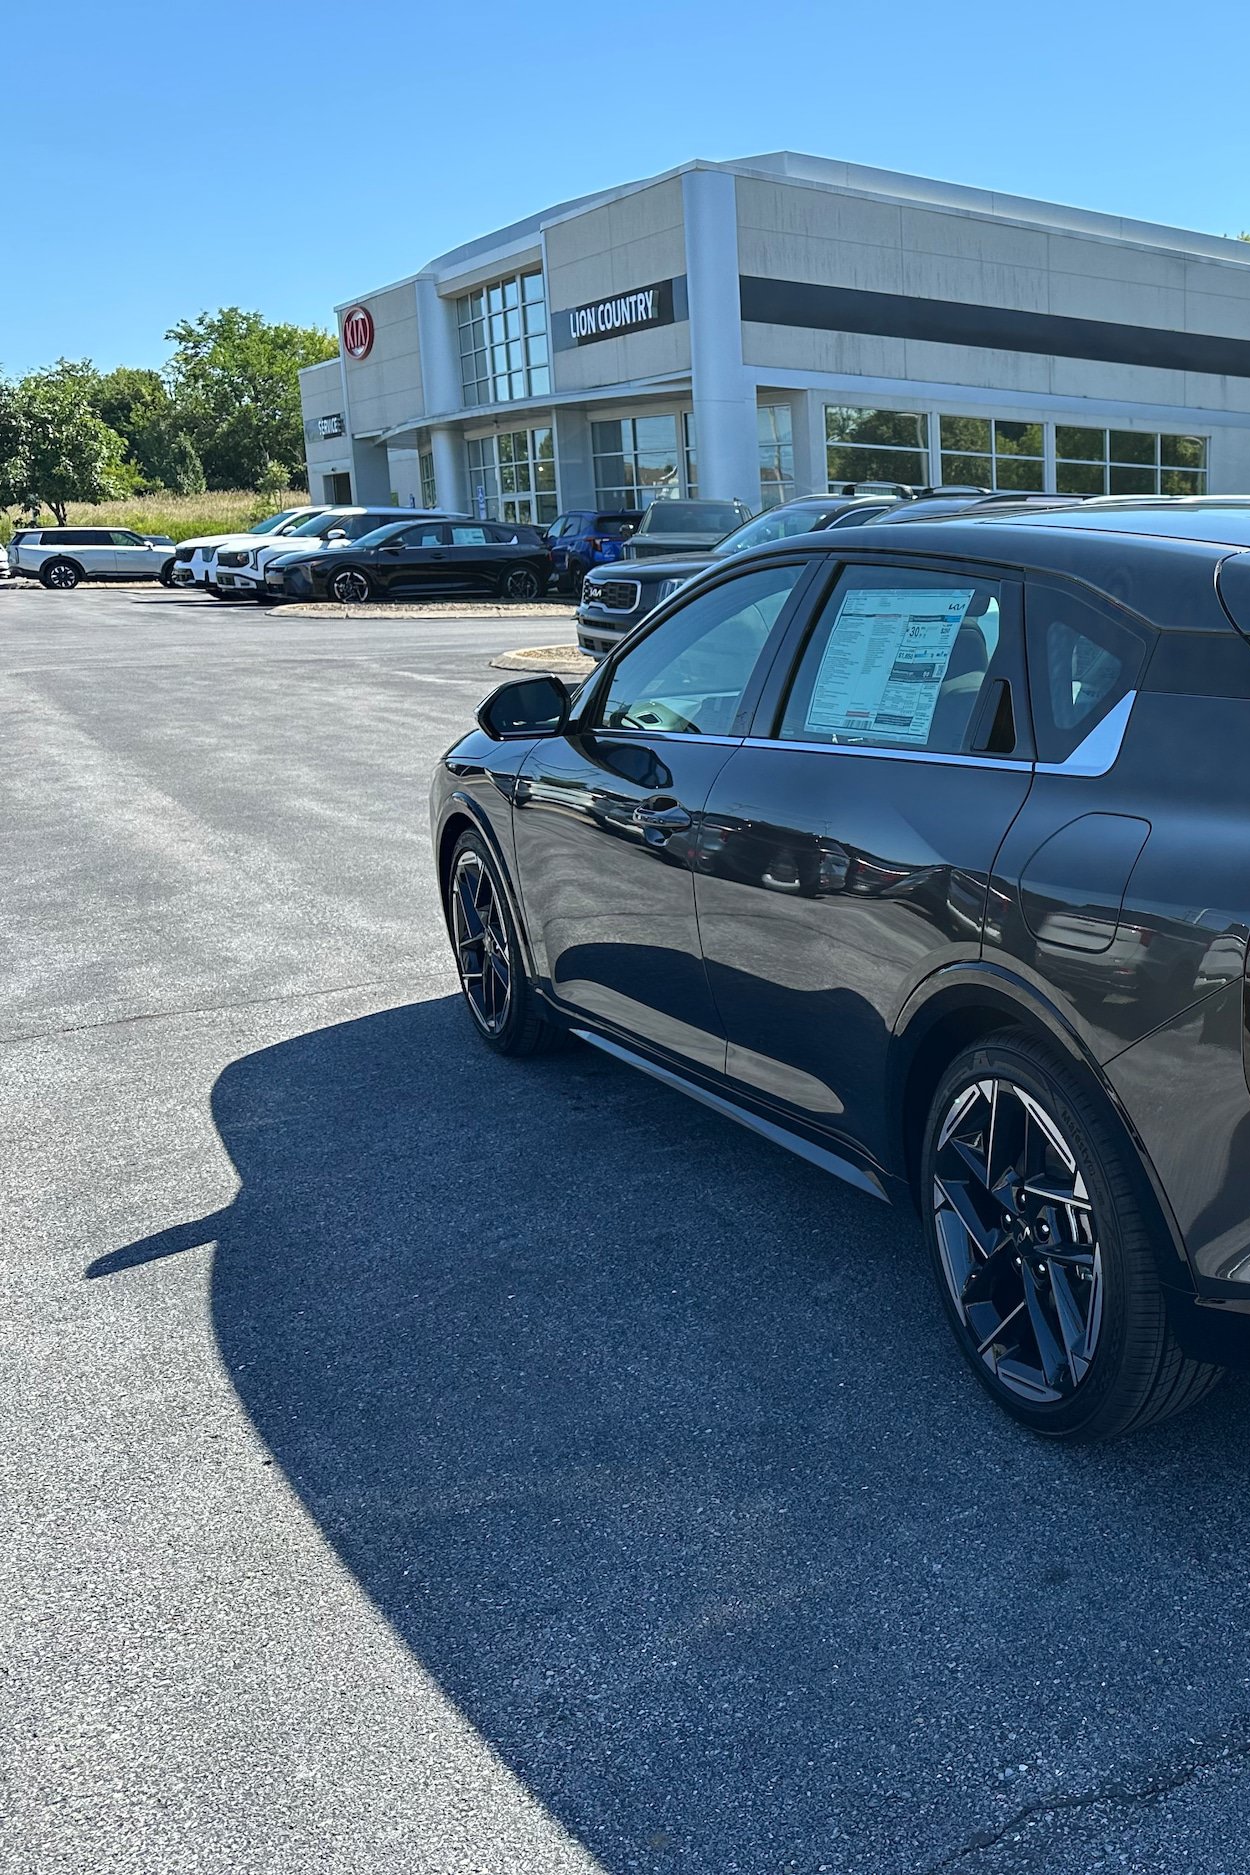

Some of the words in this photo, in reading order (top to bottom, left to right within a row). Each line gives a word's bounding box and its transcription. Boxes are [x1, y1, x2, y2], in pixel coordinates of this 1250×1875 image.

[570, 307, 596, 338] LION
[598, 290, 653, 331] COUNTRY
[344, 318, 366, 350] KIA
[318, 417, 339, 436] SERVICE
[589, 588, 602, 597] KIA
[909, 626, 920, 637] 30
